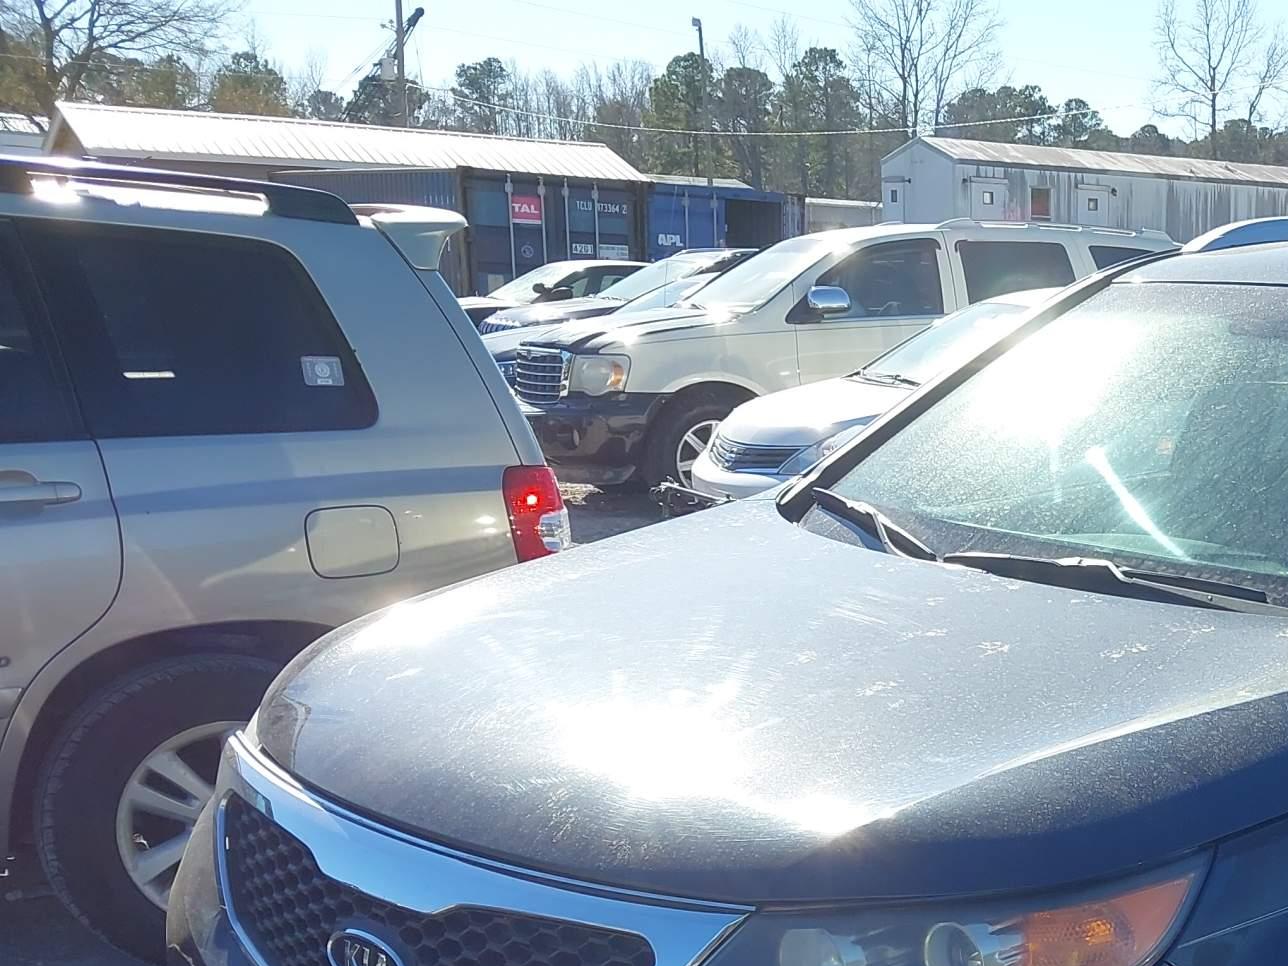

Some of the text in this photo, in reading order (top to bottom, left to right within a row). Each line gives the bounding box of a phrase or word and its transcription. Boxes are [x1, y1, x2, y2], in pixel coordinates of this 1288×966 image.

[512, 203, 540, 214] TAL
[576, 200, 593, 211] TCLU
[657, 233, 684, 247] APL
